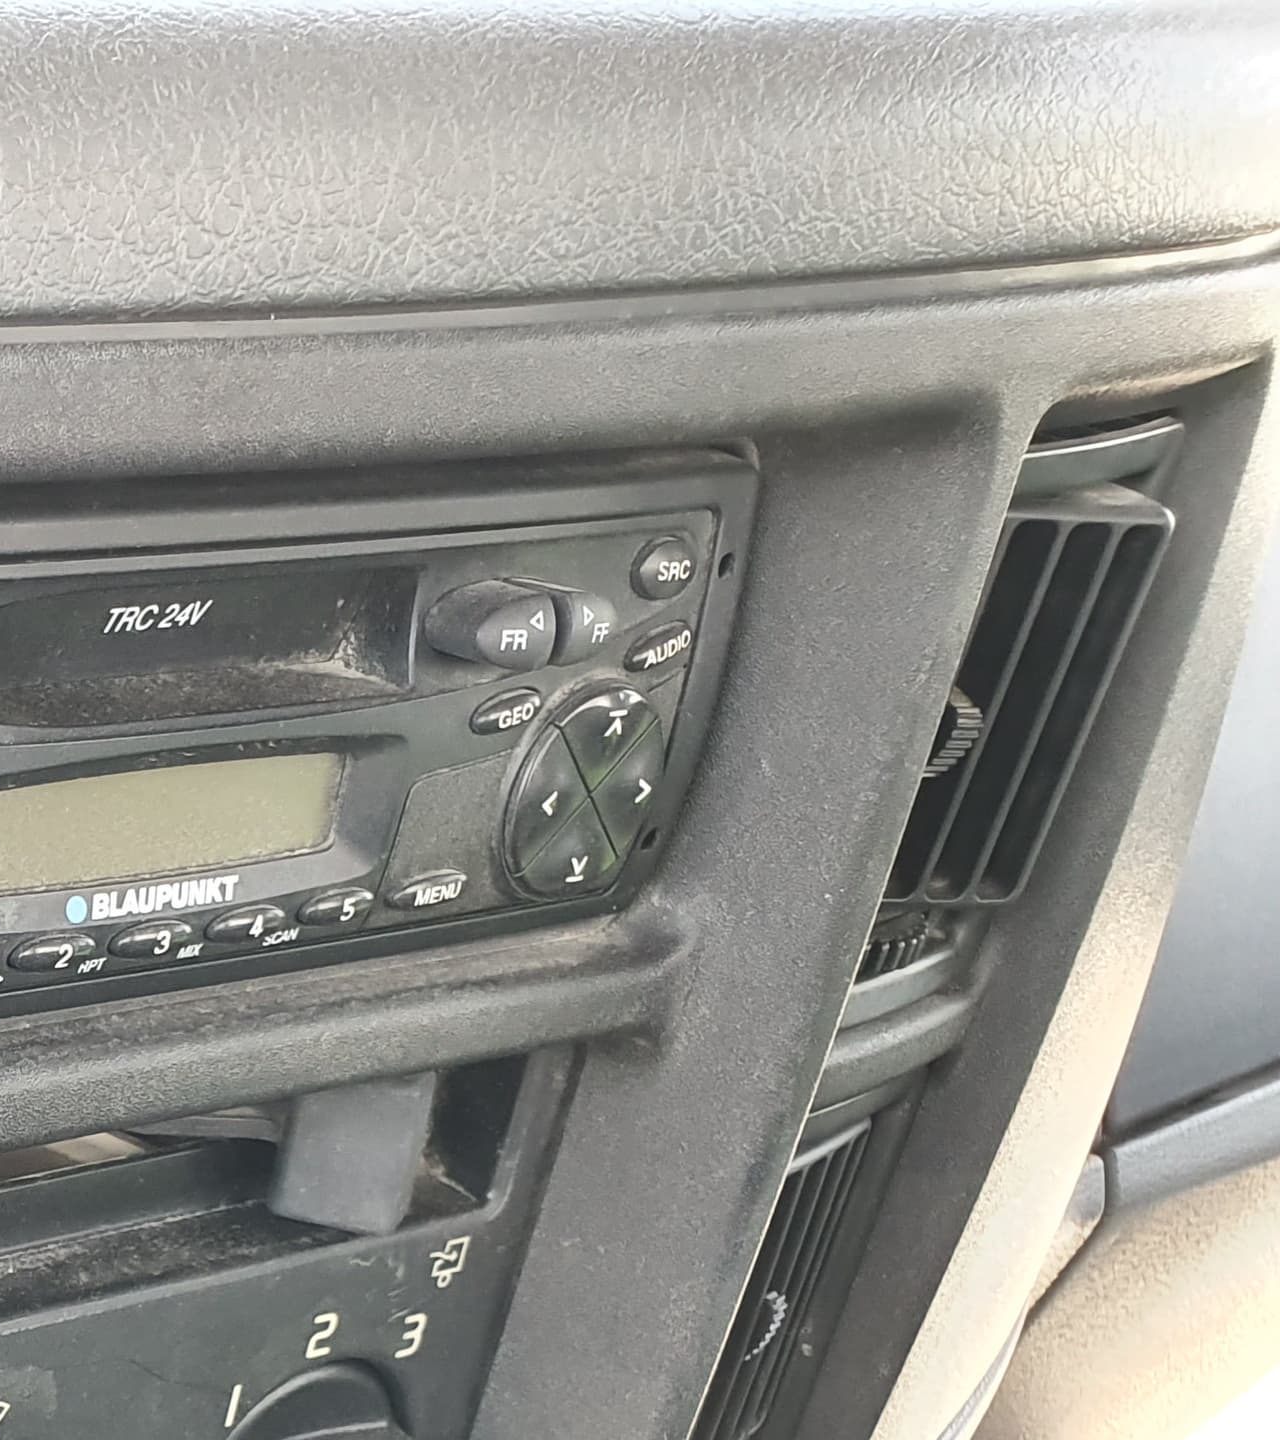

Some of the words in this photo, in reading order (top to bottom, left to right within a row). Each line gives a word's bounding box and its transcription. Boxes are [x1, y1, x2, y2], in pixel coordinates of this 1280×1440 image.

[657, 559, 691, 582] SRC
[103, 605, 159, 634] TRC
[159, 600, 213, 627] 24V
[500, 629, 528, 651] FR
[591, 623, 610, 643] FF
[644, 629, 691, 669] AUDIO
[498, 701, 535, 729] GEO
[91, 876, 239, 921] BLAUPUNKT
[414, 881, 463, 907] MENU
[340, 899, 356, 921] 5
[248, 914, 264, 938] 4
[262, 927, 299, 946] SCAN
[153, 930, 171, 955] 3
[176, 943, 204, 959] MIX
[55, 944, 74, 968] 2
[305, 1312, 338, 1359] 2
[394, 1313, 427, 1358] 3
